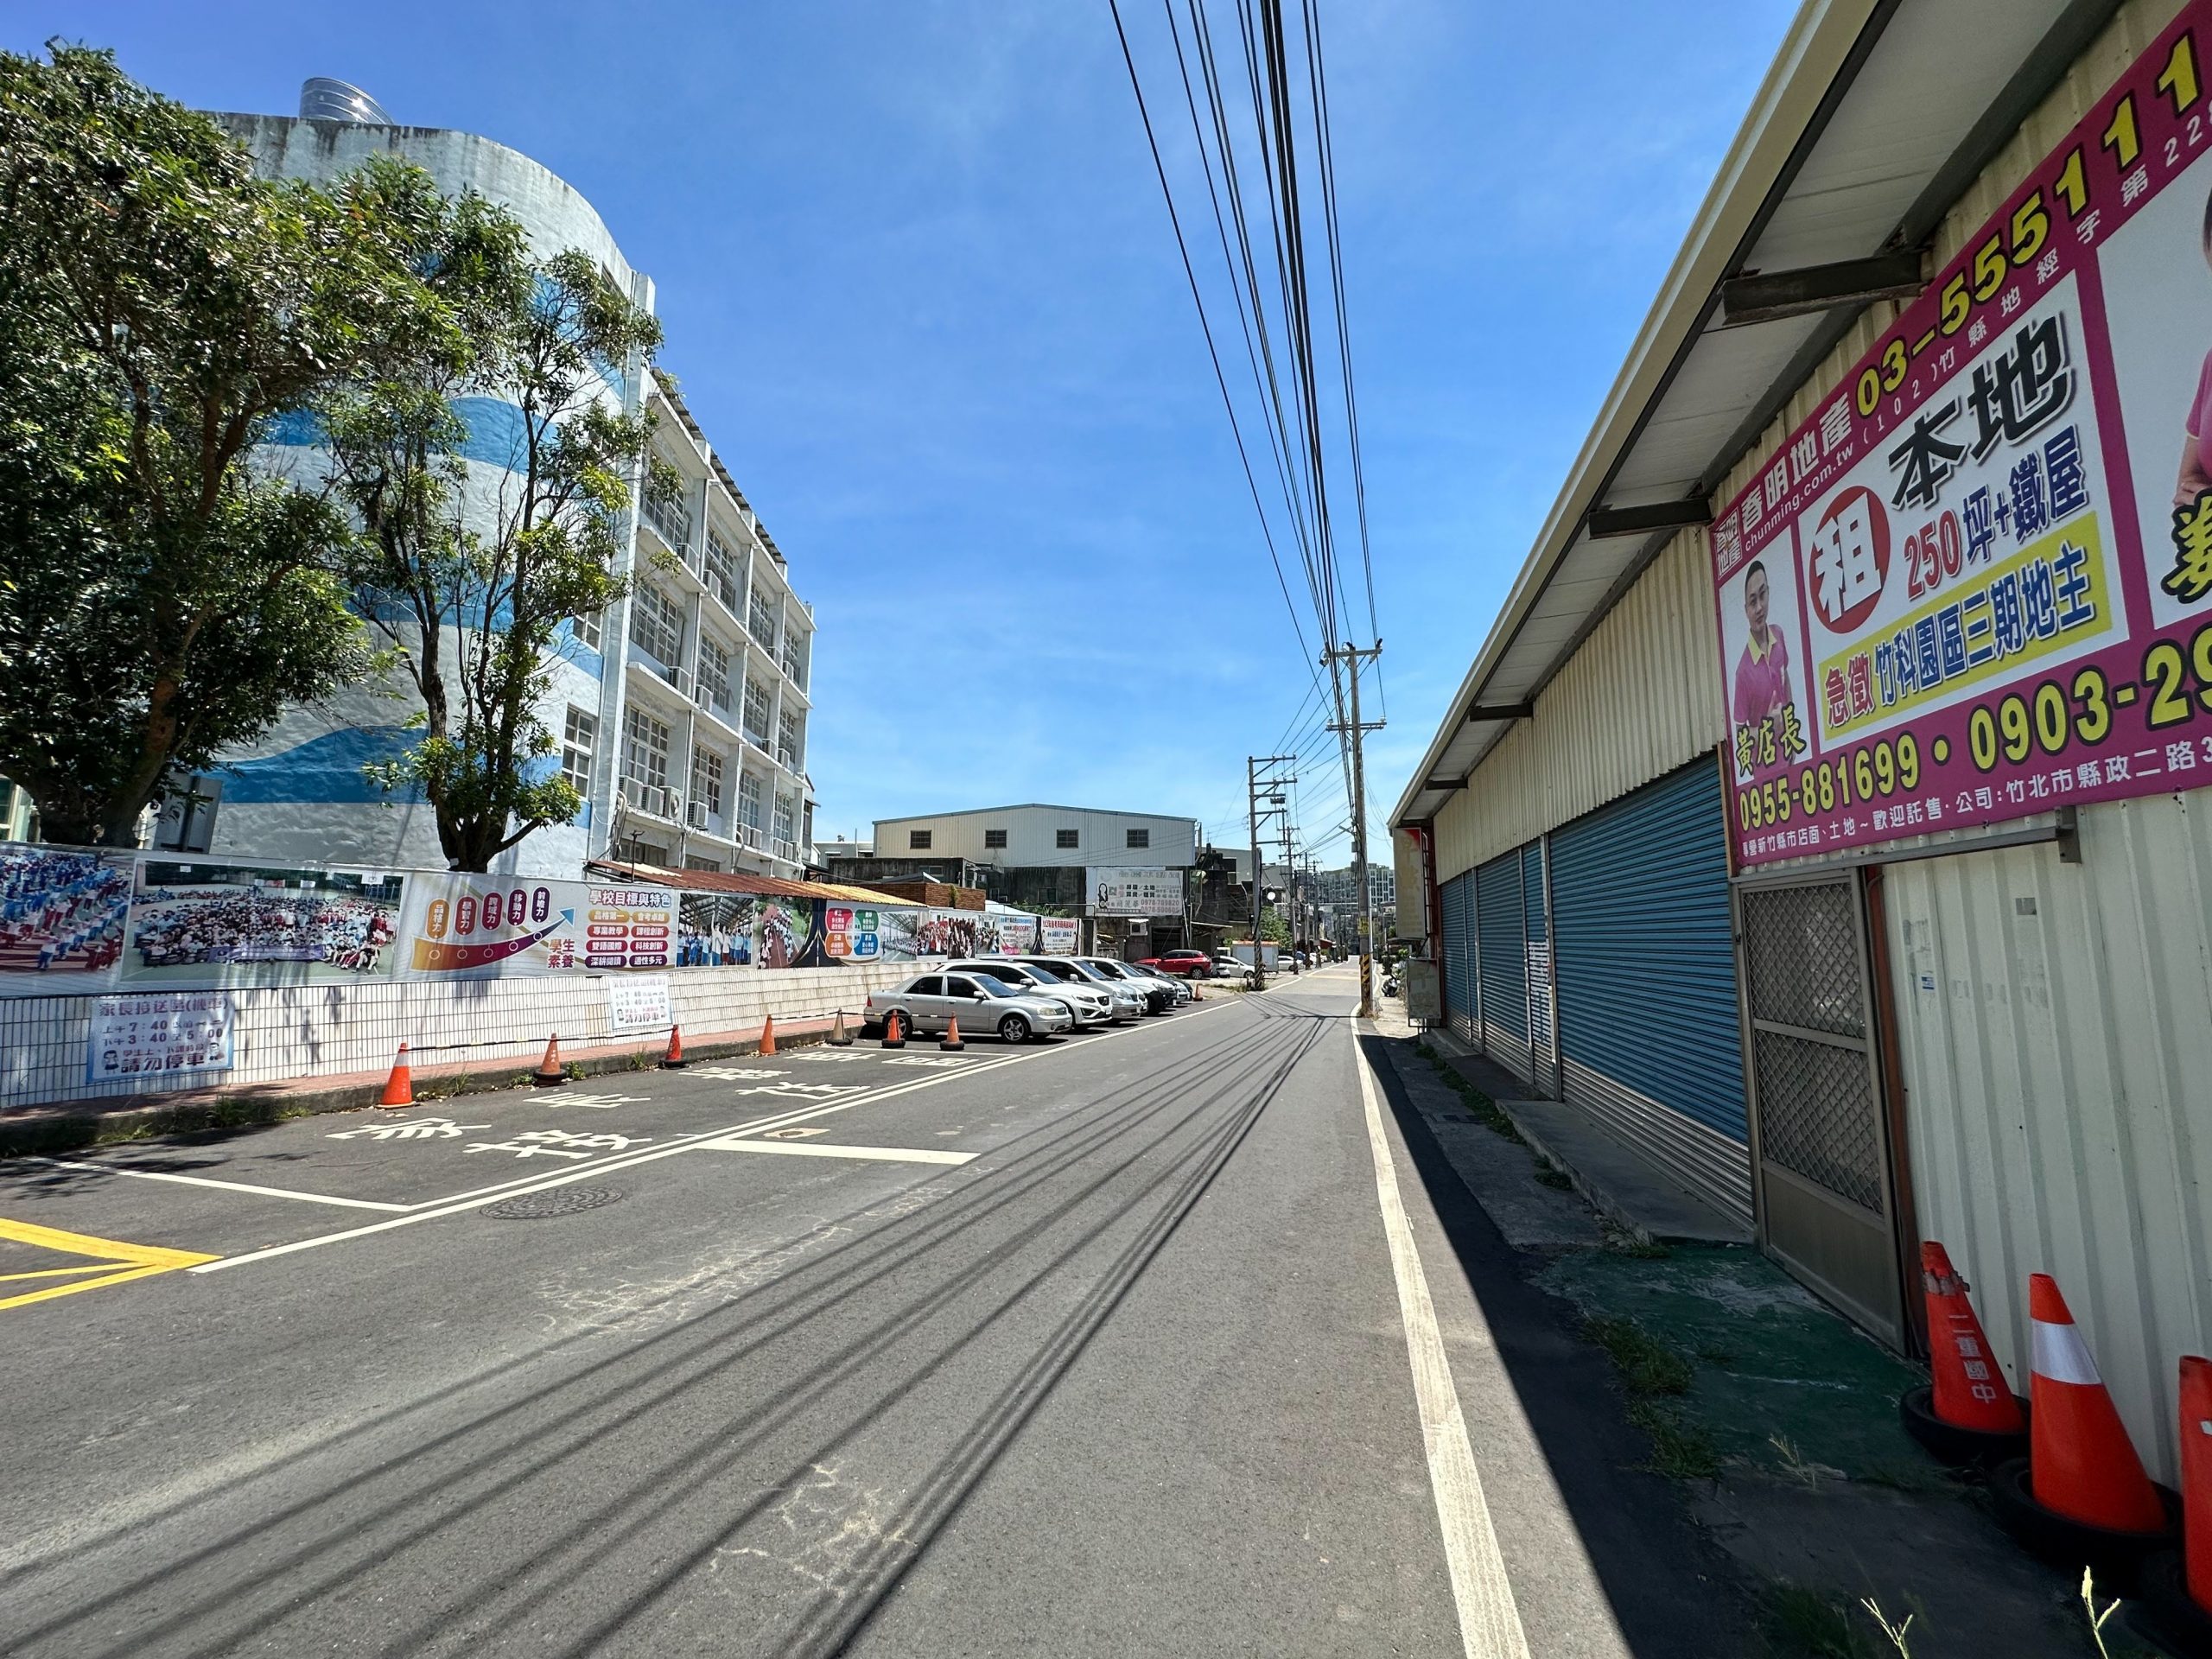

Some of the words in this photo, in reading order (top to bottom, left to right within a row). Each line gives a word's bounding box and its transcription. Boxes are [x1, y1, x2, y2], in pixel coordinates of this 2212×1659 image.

[1864, 99, 2212, 444] (102)竹縣地經字第22
[1888, 314, 2073, 506] 本地
[1741, 391, 1853, 534] 春明地產
[1745, 442, 1853, 551] chunming.com.tw
[1815, 492, 1882, 622] 租
[1736, 702, 1806, 777] 黃店長
[589, 889, 671, 907] 學校目標與特色
[547, 955, 575, 969] 素養
[548, 939, 575, 953] 學生
[121, 1052, 205, 1073] 請勿停車
